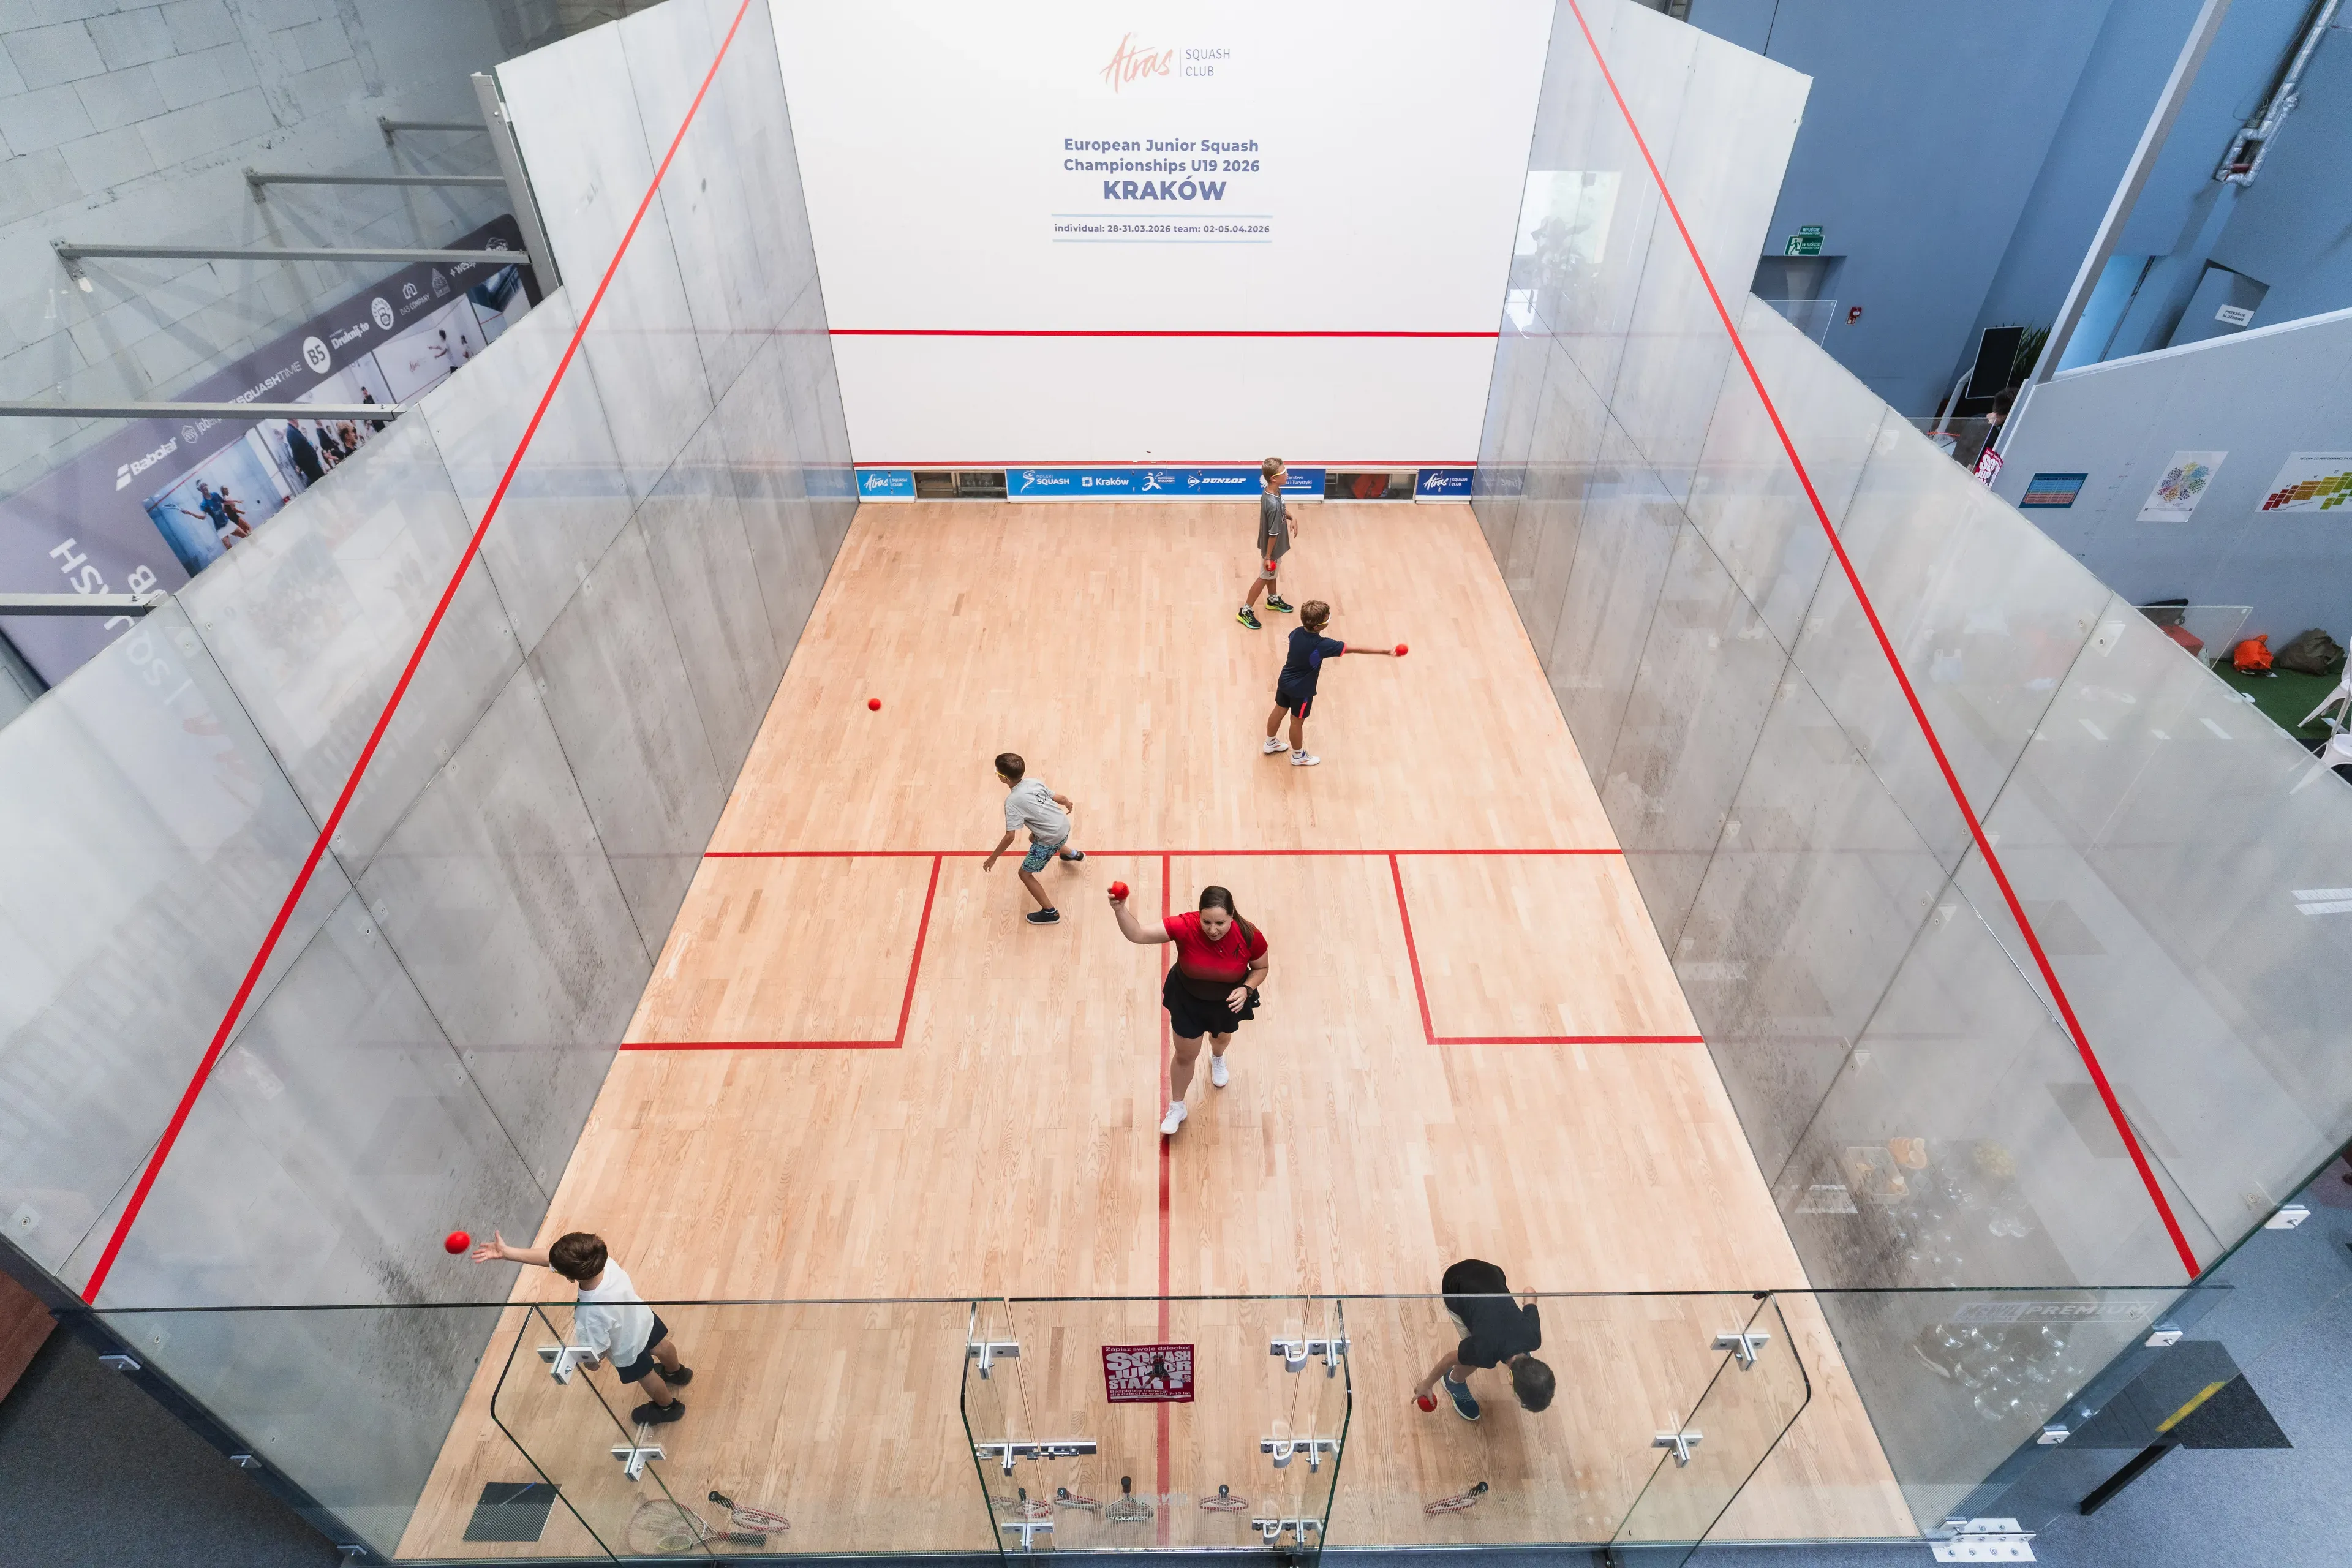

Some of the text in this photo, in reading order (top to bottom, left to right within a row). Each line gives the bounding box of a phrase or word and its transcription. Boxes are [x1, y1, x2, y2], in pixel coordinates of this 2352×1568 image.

[1099, 32, 1174, 94] Atras
[1186, 48, 1231, 61] SQUASH
[1186, 66, 1214, 77] CLUB
[1064, 138, 1259, 154] European Junior Squash
[1063, 157, 1260, 174] Championships U19 2026
[1103, 175, 1227, 200] KRAKÓW
[1055, 223, 1105, 232] individual:
[1107, 224, 1171, 233] 28-31.03.2026
[1204, 225, 1270, 233] 02-05.04.2026
[409, 293, 431, 310] COMPANY
[307, 345, 326, 366] B5
[1095, 477, 1129, 486] Kraków
[1108, 1360, 1191, 1380] JUNOR
